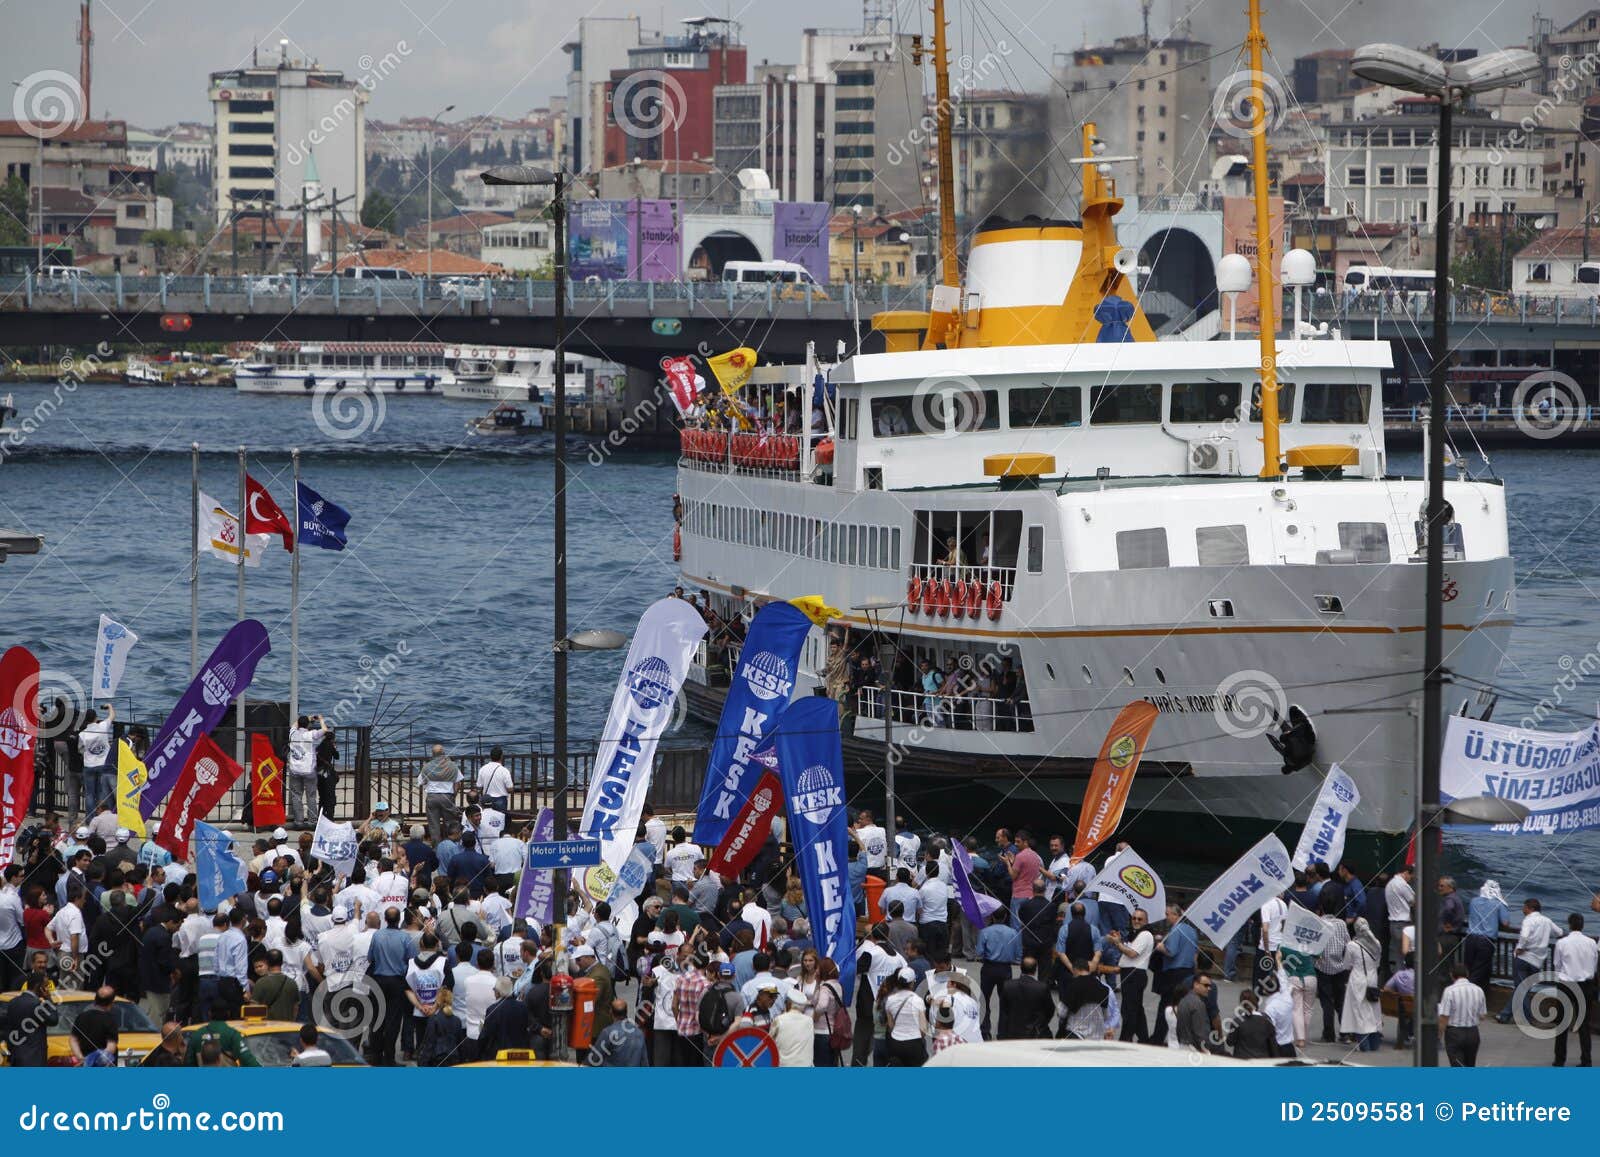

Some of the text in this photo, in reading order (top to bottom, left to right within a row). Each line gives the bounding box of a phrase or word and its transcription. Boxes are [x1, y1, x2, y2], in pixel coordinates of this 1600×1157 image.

[201, 668, 232, 707] KESK
[624, 670, 674, 706] KESK
[741, 663, 793, 698] KESK
[588, 719, 647, 841] KESK
[713, 707, 768, 820] KESK
[790, 786, 843, 814] KESK
[532, 844, 598, 855] Motor İskeleleri
[723, 808, 761, 863] KESK
